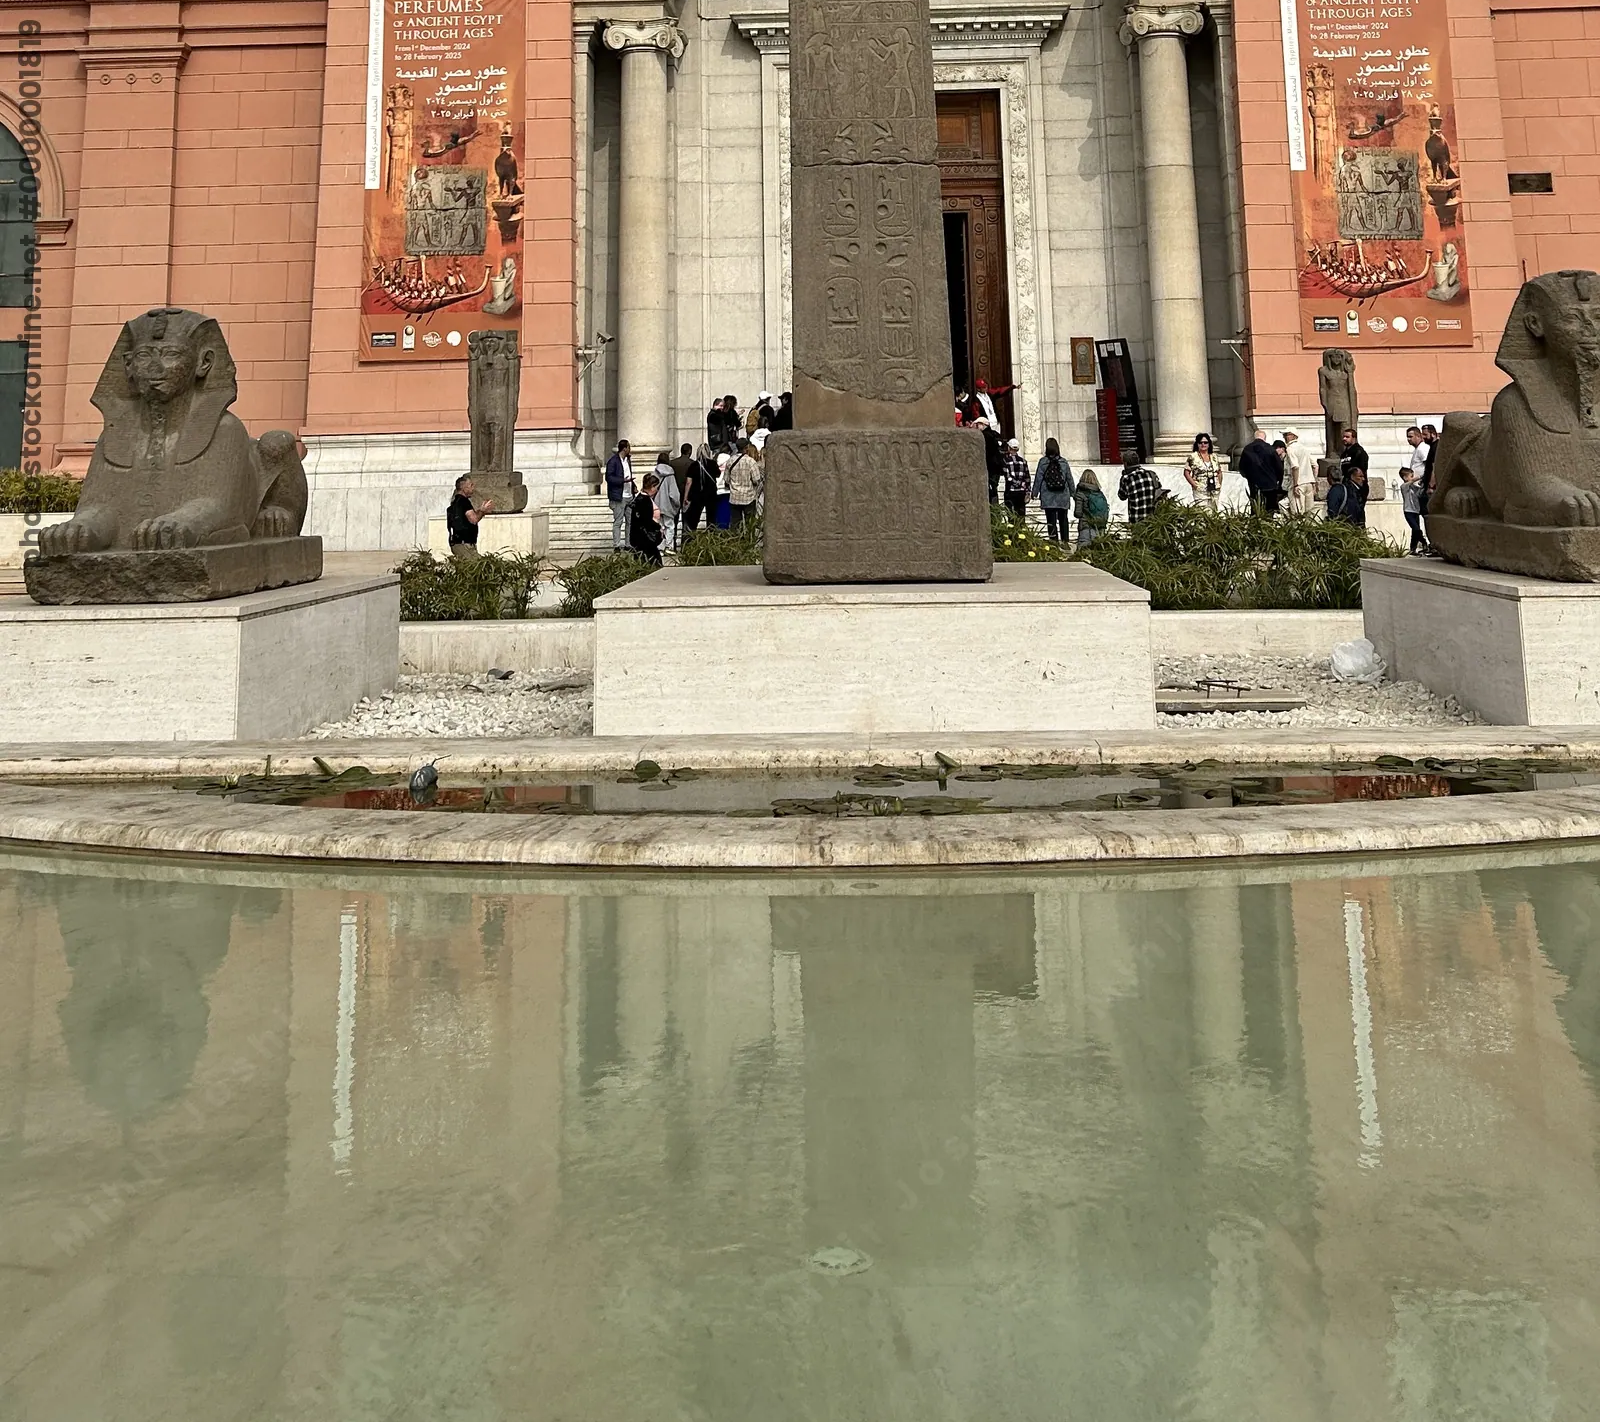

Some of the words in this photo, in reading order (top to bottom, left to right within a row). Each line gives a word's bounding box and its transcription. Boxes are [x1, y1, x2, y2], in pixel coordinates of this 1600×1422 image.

[394, 0, 484, 14] PERFUMES
[1307, 8, 1375, 19] THROUGH
[1380, 7, 1413, 17] AGES
[406, 15, 461, 27] ANCIENT
[464, 14, 503, 25] EGYPT
[394, 29, 458, 40] THROUGH
[463, 28, 494, 38] AGES
[1319, 32, 1328, 40] 28
[1330, 32, 1360, 41] February
[1362, 31, 1381, 39] 2025
[403, 53, 412, 61] 28
[414, 53, 442, 61] February
[1312, 46, 1357, 60] القديمة
[1360, 48, 1392, 60] مصر
[1395, 45, 1430, 60] عطور
[395, 66, 438, 81] القديمة
[440, 68, 471, 80] مصر
[474, 64, 508, 79] عطور
[1355, 61, 1404, 76] العصور
[1408, 62, 1431, 75] عبر
[435, 80, 482, 96] العصور
[485, 81, 508, 94] عبر
[1369, 79, 1400, 87] ديسمبر
[1376, 90, 1399, 100] فبراير
[447, 99, 477, 107] ديسمبر
[452, 108, 474, 119] فبراير
